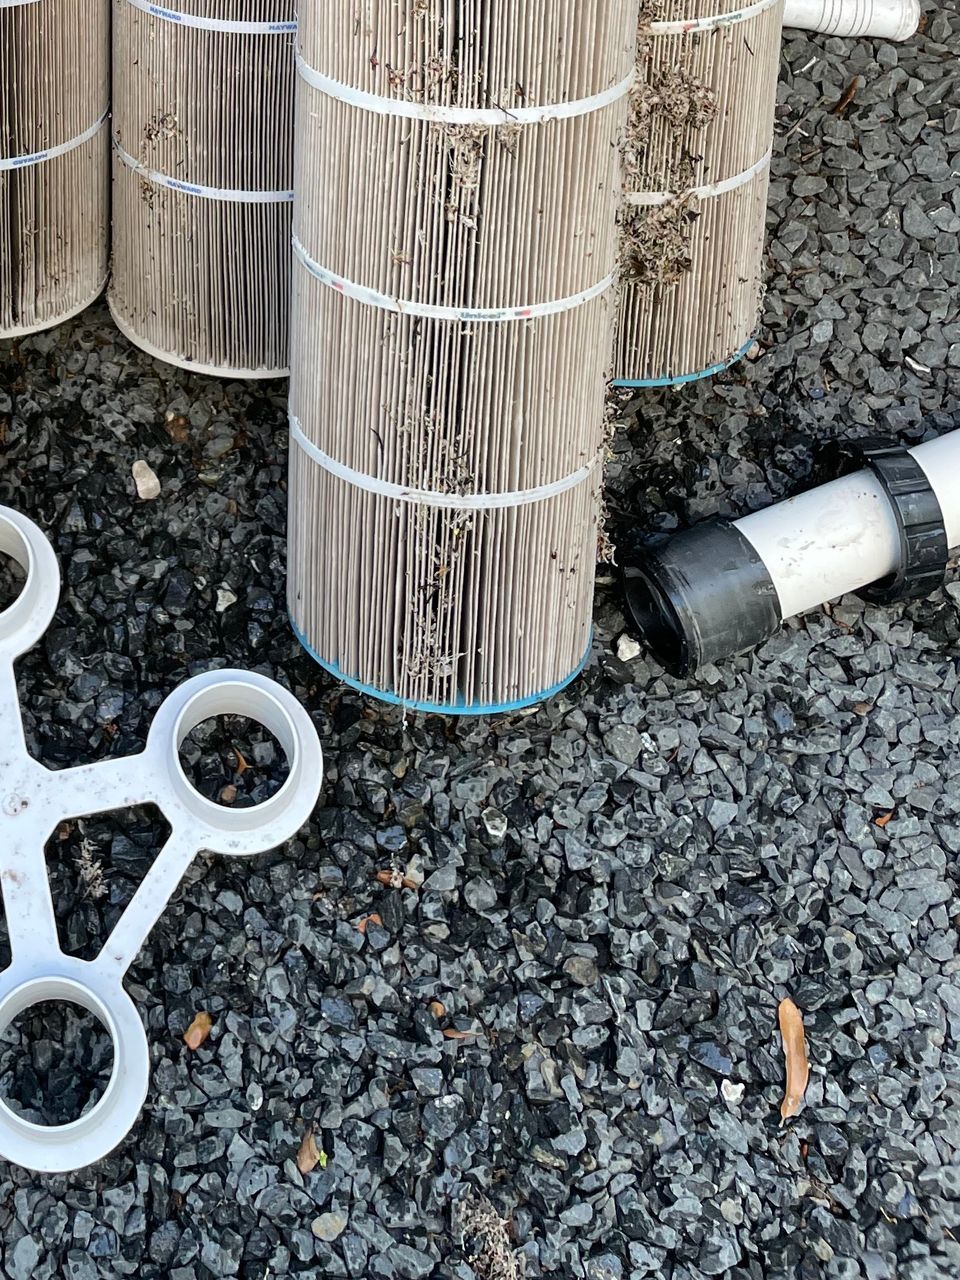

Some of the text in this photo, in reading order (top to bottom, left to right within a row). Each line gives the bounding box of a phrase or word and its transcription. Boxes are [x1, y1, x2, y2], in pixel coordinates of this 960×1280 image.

[149, 6, 182, 21] HAYWARD
[12, 152, 48, 166] HAYWARD
[166, 180, 202, 195] HAYWARD
